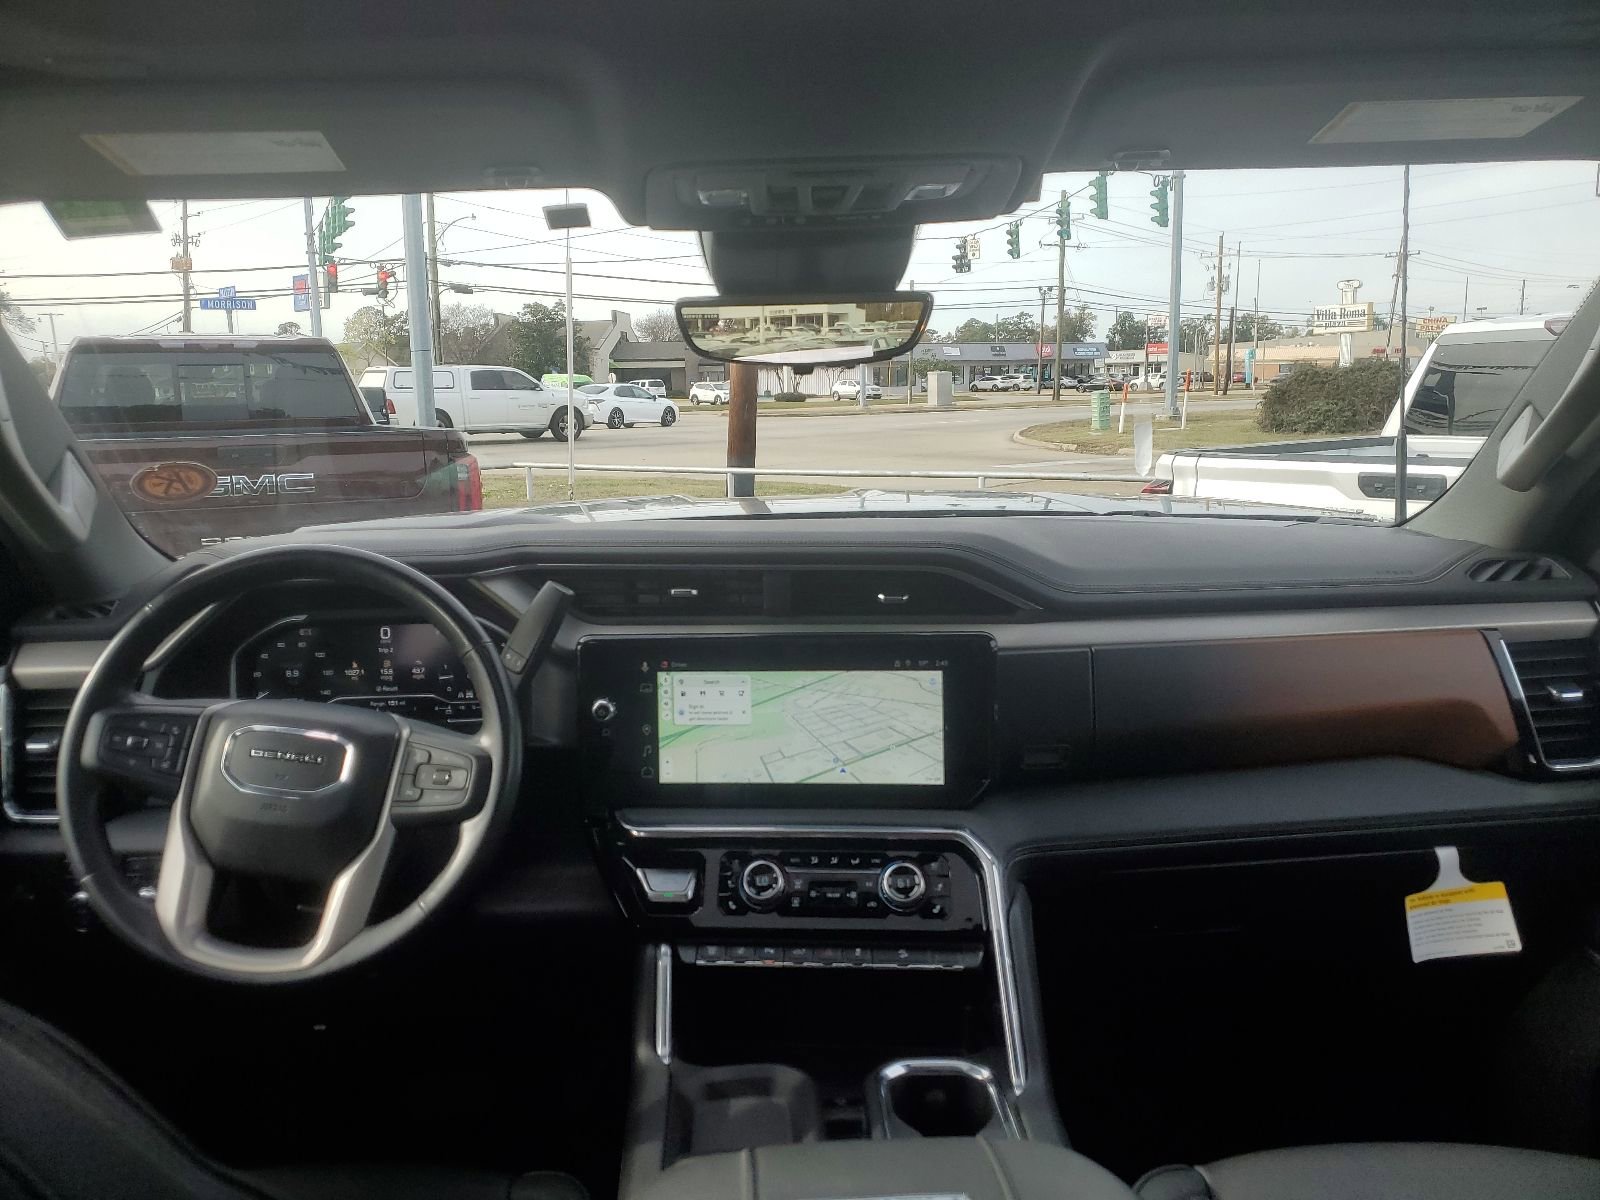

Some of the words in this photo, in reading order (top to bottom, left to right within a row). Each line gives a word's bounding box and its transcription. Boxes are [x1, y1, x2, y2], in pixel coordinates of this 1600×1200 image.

[206, 300, 254, 309] MORRISON
[1316, 309, 1337, 322] Villa
[1339, 307, 1366, 320] Roma
[1422, 316, 1448, 325] CHINA
[1324, 320, 1346, 329] plaza
[203, 472, 316, 498] GMC
[249, 749, 322, 764] DENALI
